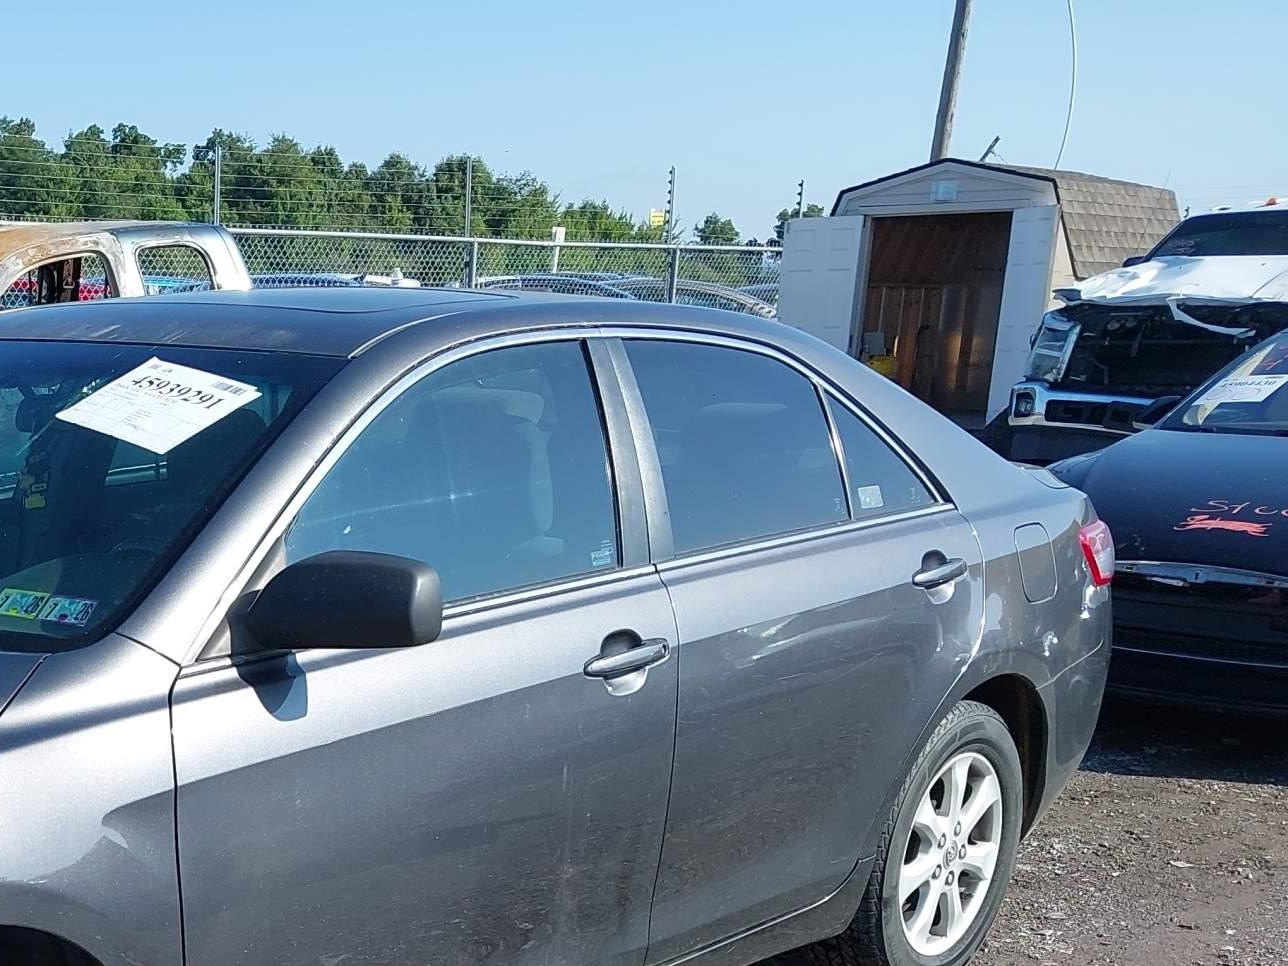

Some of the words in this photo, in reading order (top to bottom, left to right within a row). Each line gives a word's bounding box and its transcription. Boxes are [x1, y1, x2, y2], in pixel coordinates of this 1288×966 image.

[131, 375, 225, 410] 45939291
[23, 595, 45, 614] 26
[45, 602, 59, 619] 7
[73, 602, 94, 621] 26
